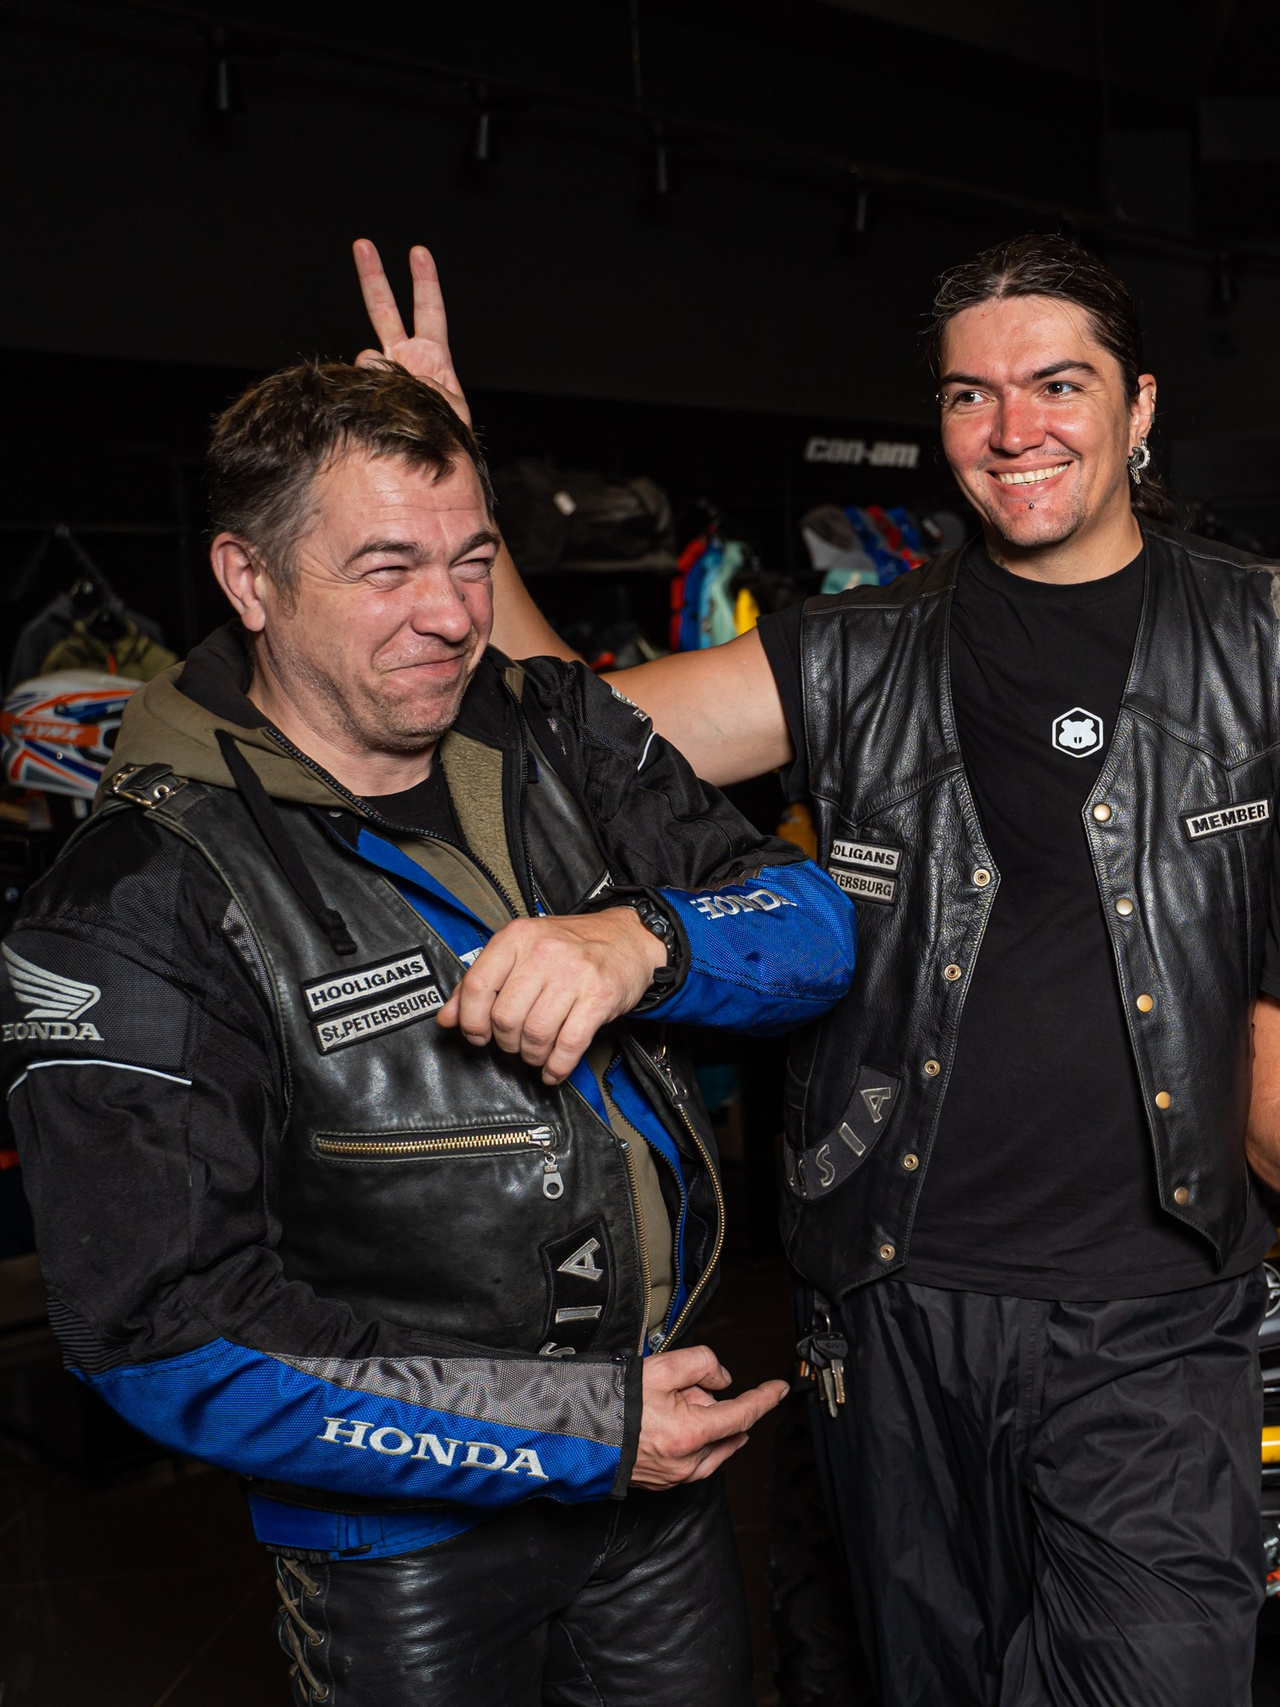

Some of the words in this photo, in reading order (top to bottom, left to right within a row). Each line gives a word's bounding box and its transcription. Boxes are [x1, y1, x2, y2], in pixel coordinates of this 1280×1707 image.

[1192, 804, 1266, 833] MEMBER
[832, 844, 895, 866] OLIGANS
[832, 873, 892, 897] TERSBURG
[311, 960, 424, 1006] HOOLIGANS
[2, 1021, 105, 1041] HONDA
[317, 1416, 549, 1481] HONDA
